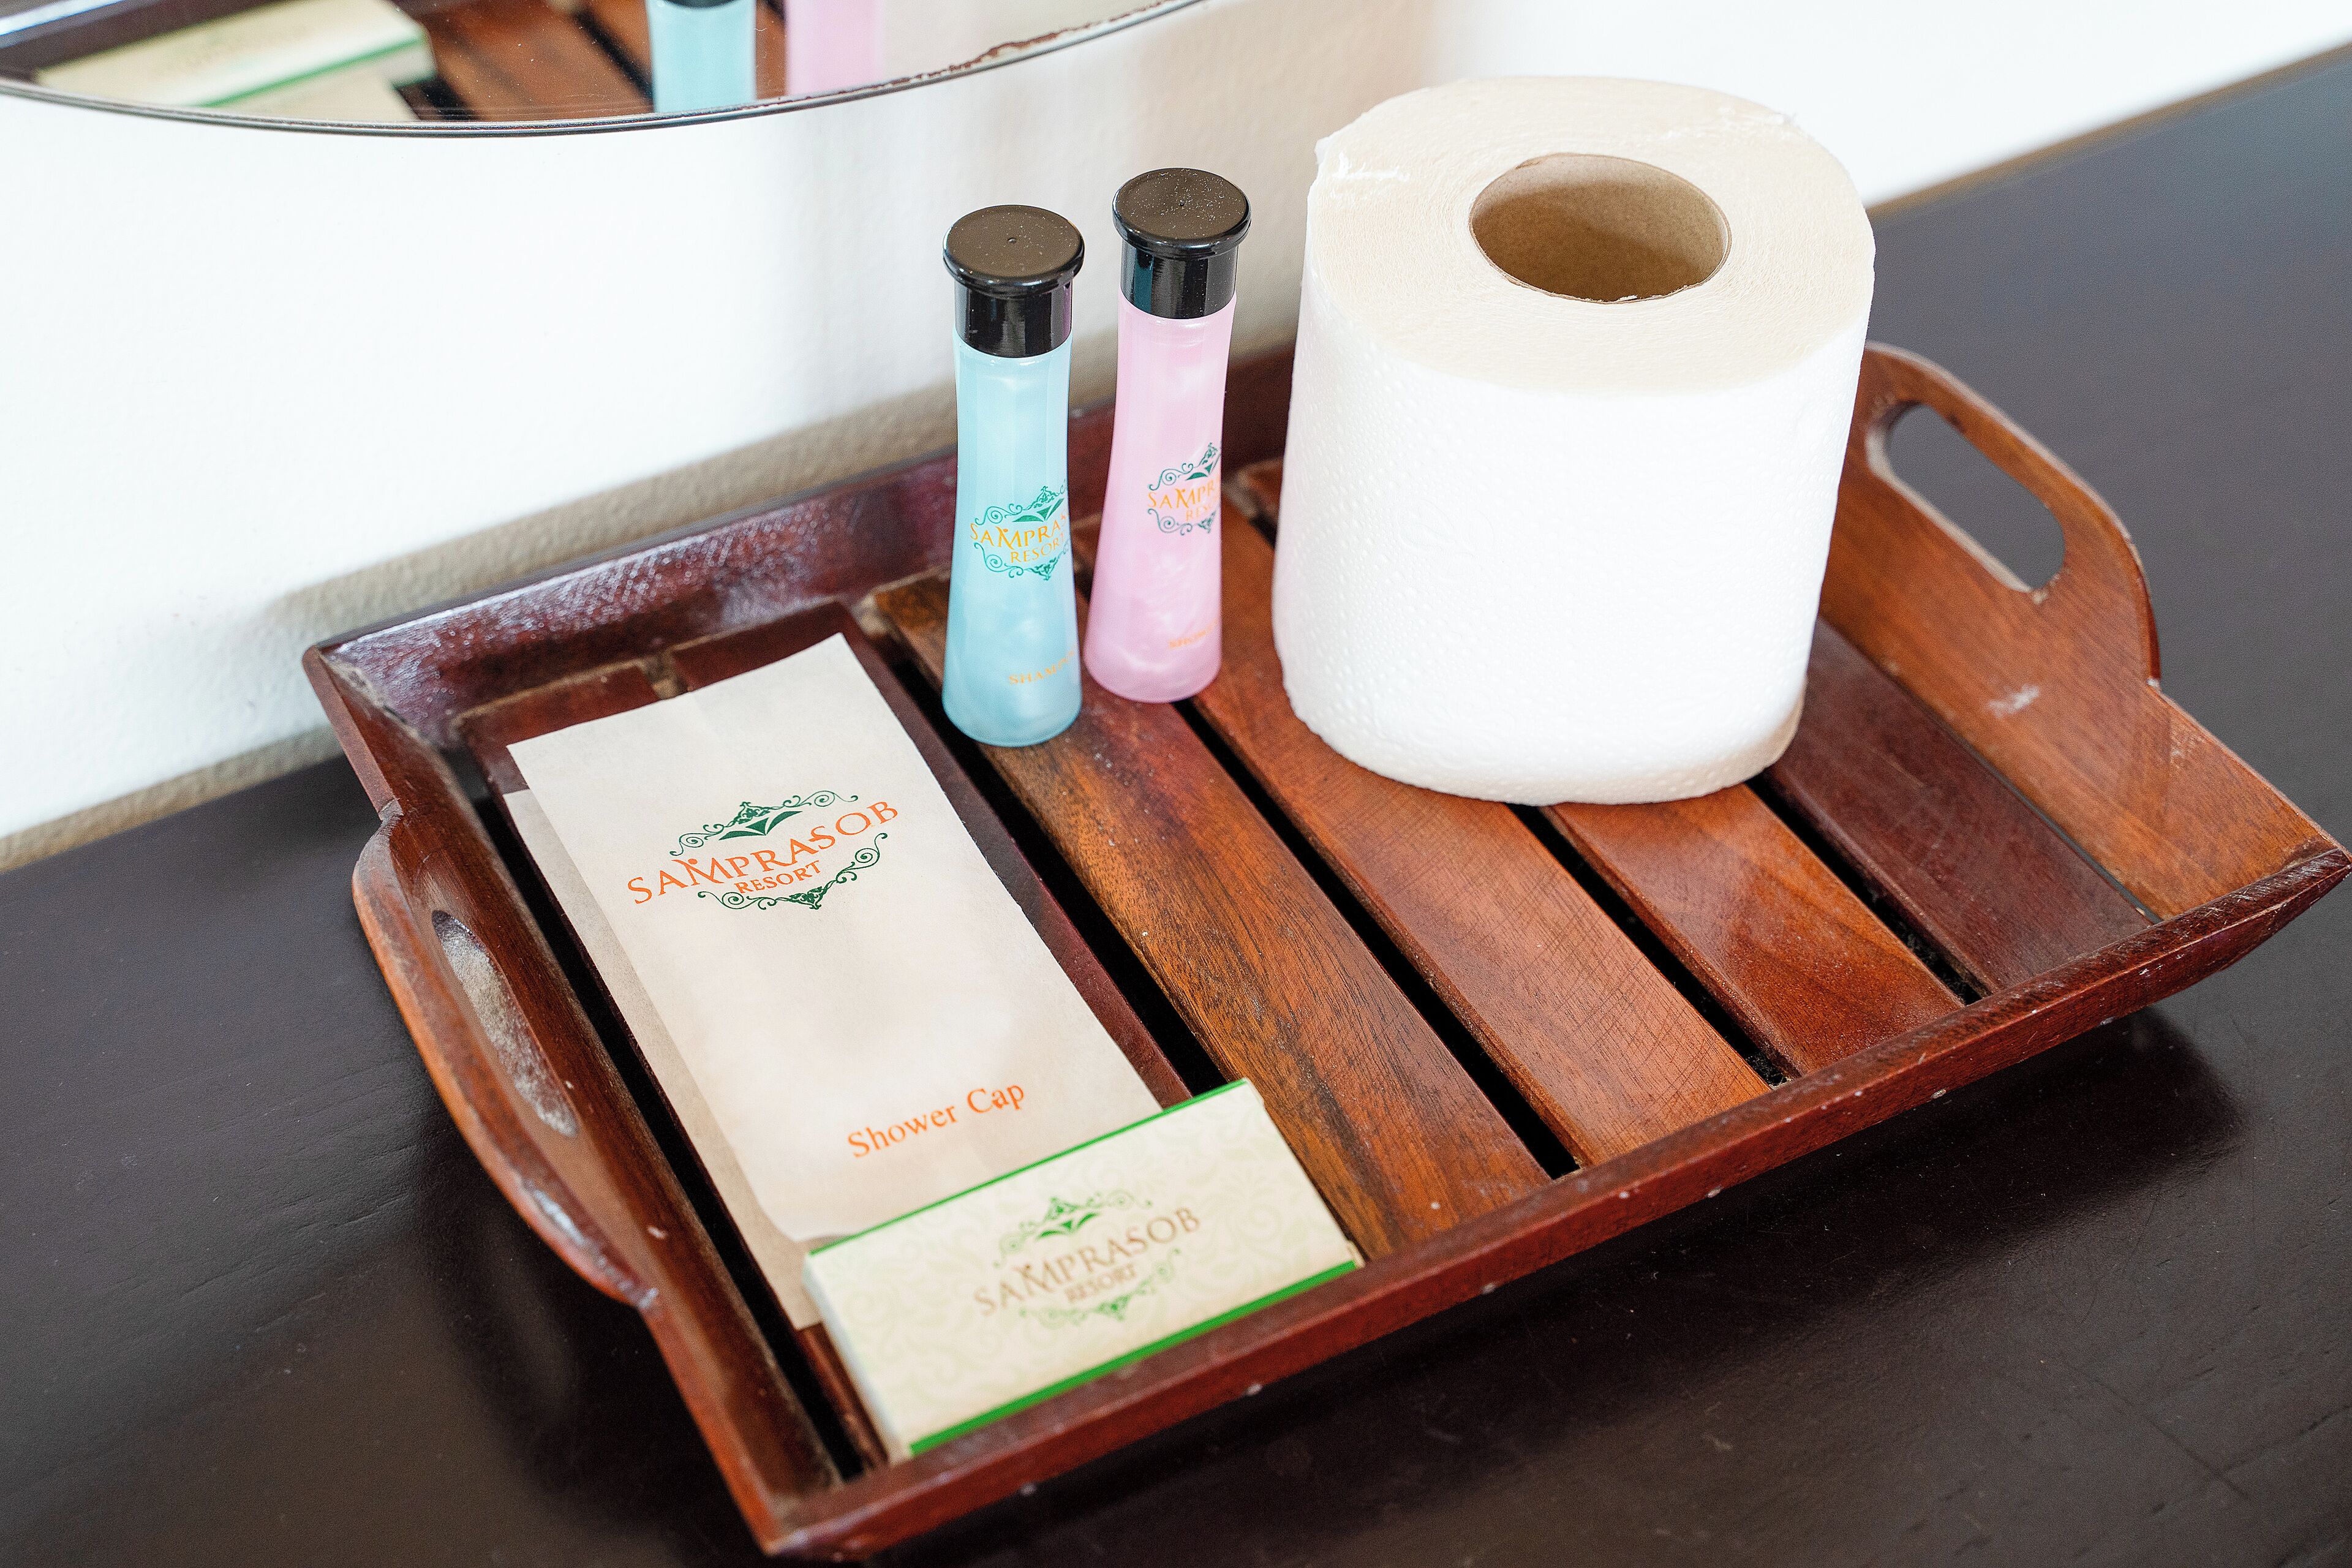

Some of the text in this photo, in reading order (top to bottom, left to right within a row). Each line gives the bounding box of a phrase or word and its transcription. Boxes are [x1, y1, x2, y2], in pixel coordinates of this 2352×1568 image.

[1147, 477, 1218, 510] SAMPR
[627, 801, 899, 905] SAMPRASOB
[734, 860, 821, 894] RESORT
[847, 1084, 1025, 1158] Shower Cap
[974, 1206, 1200, 1316] SAMPRASOB
[1064, 1262, 1137, 1304] RESORT
